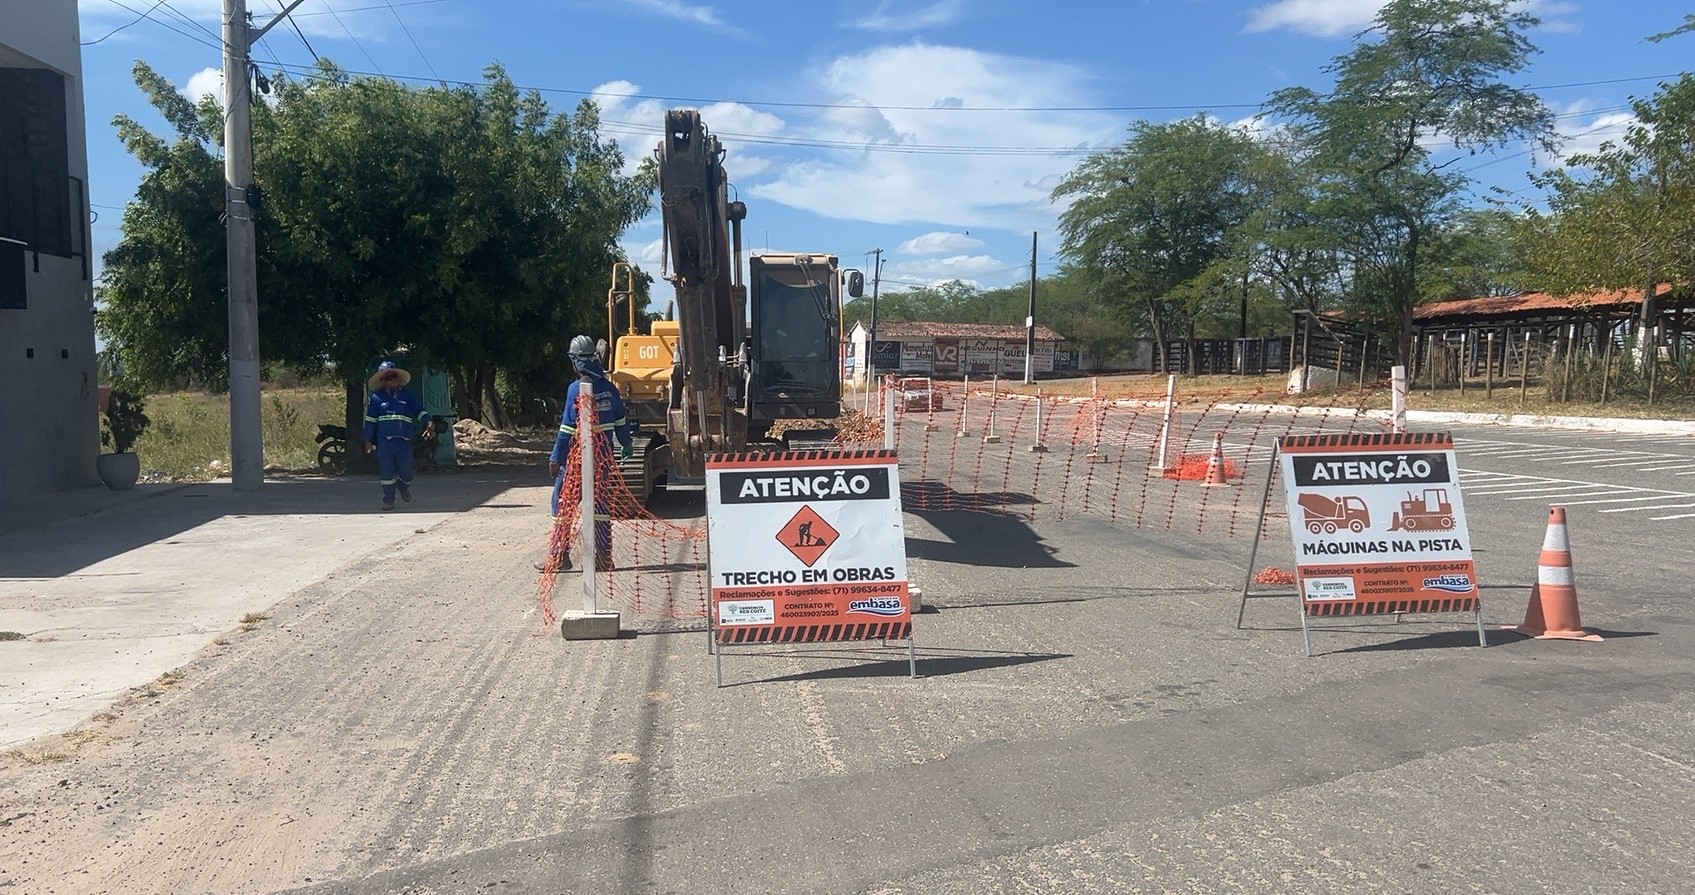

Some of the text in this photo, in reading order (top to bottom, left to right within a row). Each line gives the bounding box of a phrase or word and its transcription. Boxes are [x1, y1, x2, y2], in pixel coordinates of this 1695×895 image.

[935, 345, 957, 361] VR
[1312, 455, 1431, 482] ATENÇÃO
[739, 470, 870, 499] ATENÇÃO
[1303, 538, 1463, 555] MÁQUINAS NA PISTA
[722, 567, 896, 586] TRECHO EM OBRAS
[1303, 567, 1355, 576] Reclamações
[1363, 566, 1405, 574] Sugestões:
[1406, 565, 1421, 573] (71)
[1422, 564, 1469, 572] 99634-8477
[1424, 576, 1470, 587] embasa
[720, 589, 776, 599] Reclamações
[785, 588, 831, 597] Sugestões:
[833, 586, 849, 595] (71)
[850, 585, 902, 594] 99634-8477
[850, 598, 901, 610] embasa
[780, 610, 839, 618] 460023907/2025
